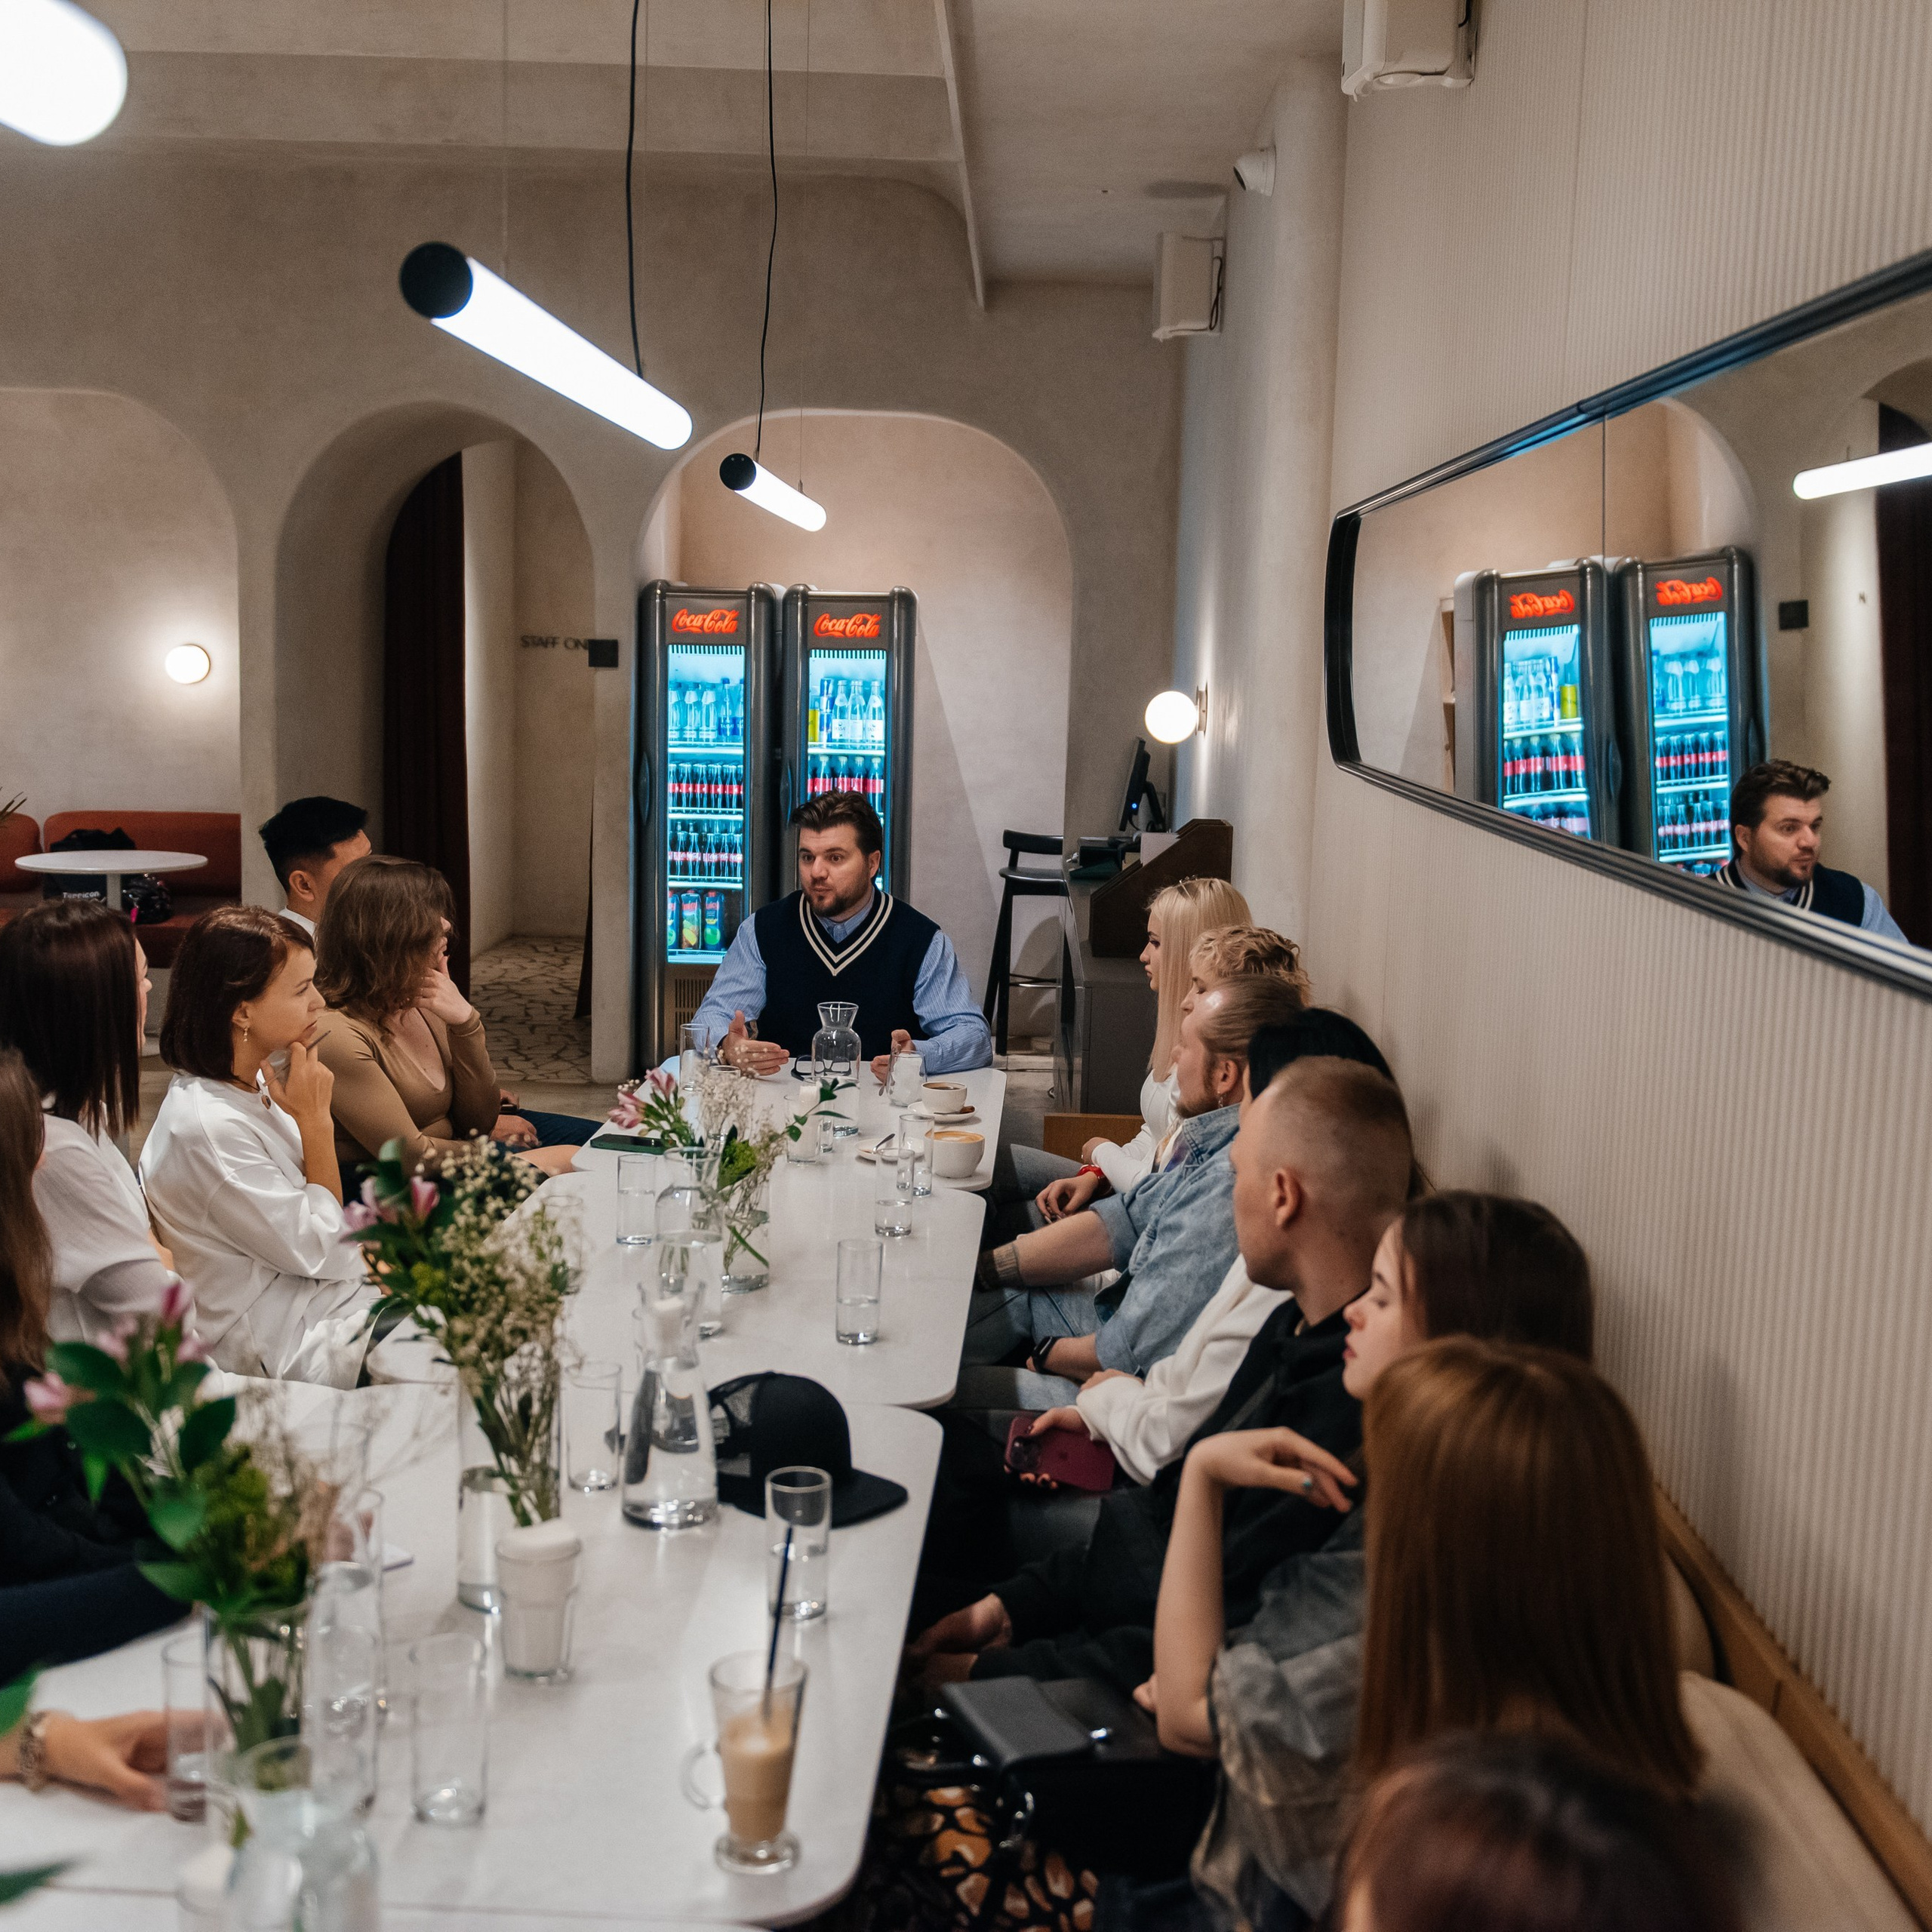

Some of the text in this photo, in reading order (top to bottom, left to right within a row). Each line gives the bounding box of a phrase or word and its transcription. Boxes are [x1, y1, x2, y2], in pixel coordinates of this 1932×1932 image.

[672, 608, 739, 634] Coca-Cola
[814, 613, 881, 638] Coca-Cola
[521, 635, 559, 648] STAFF
